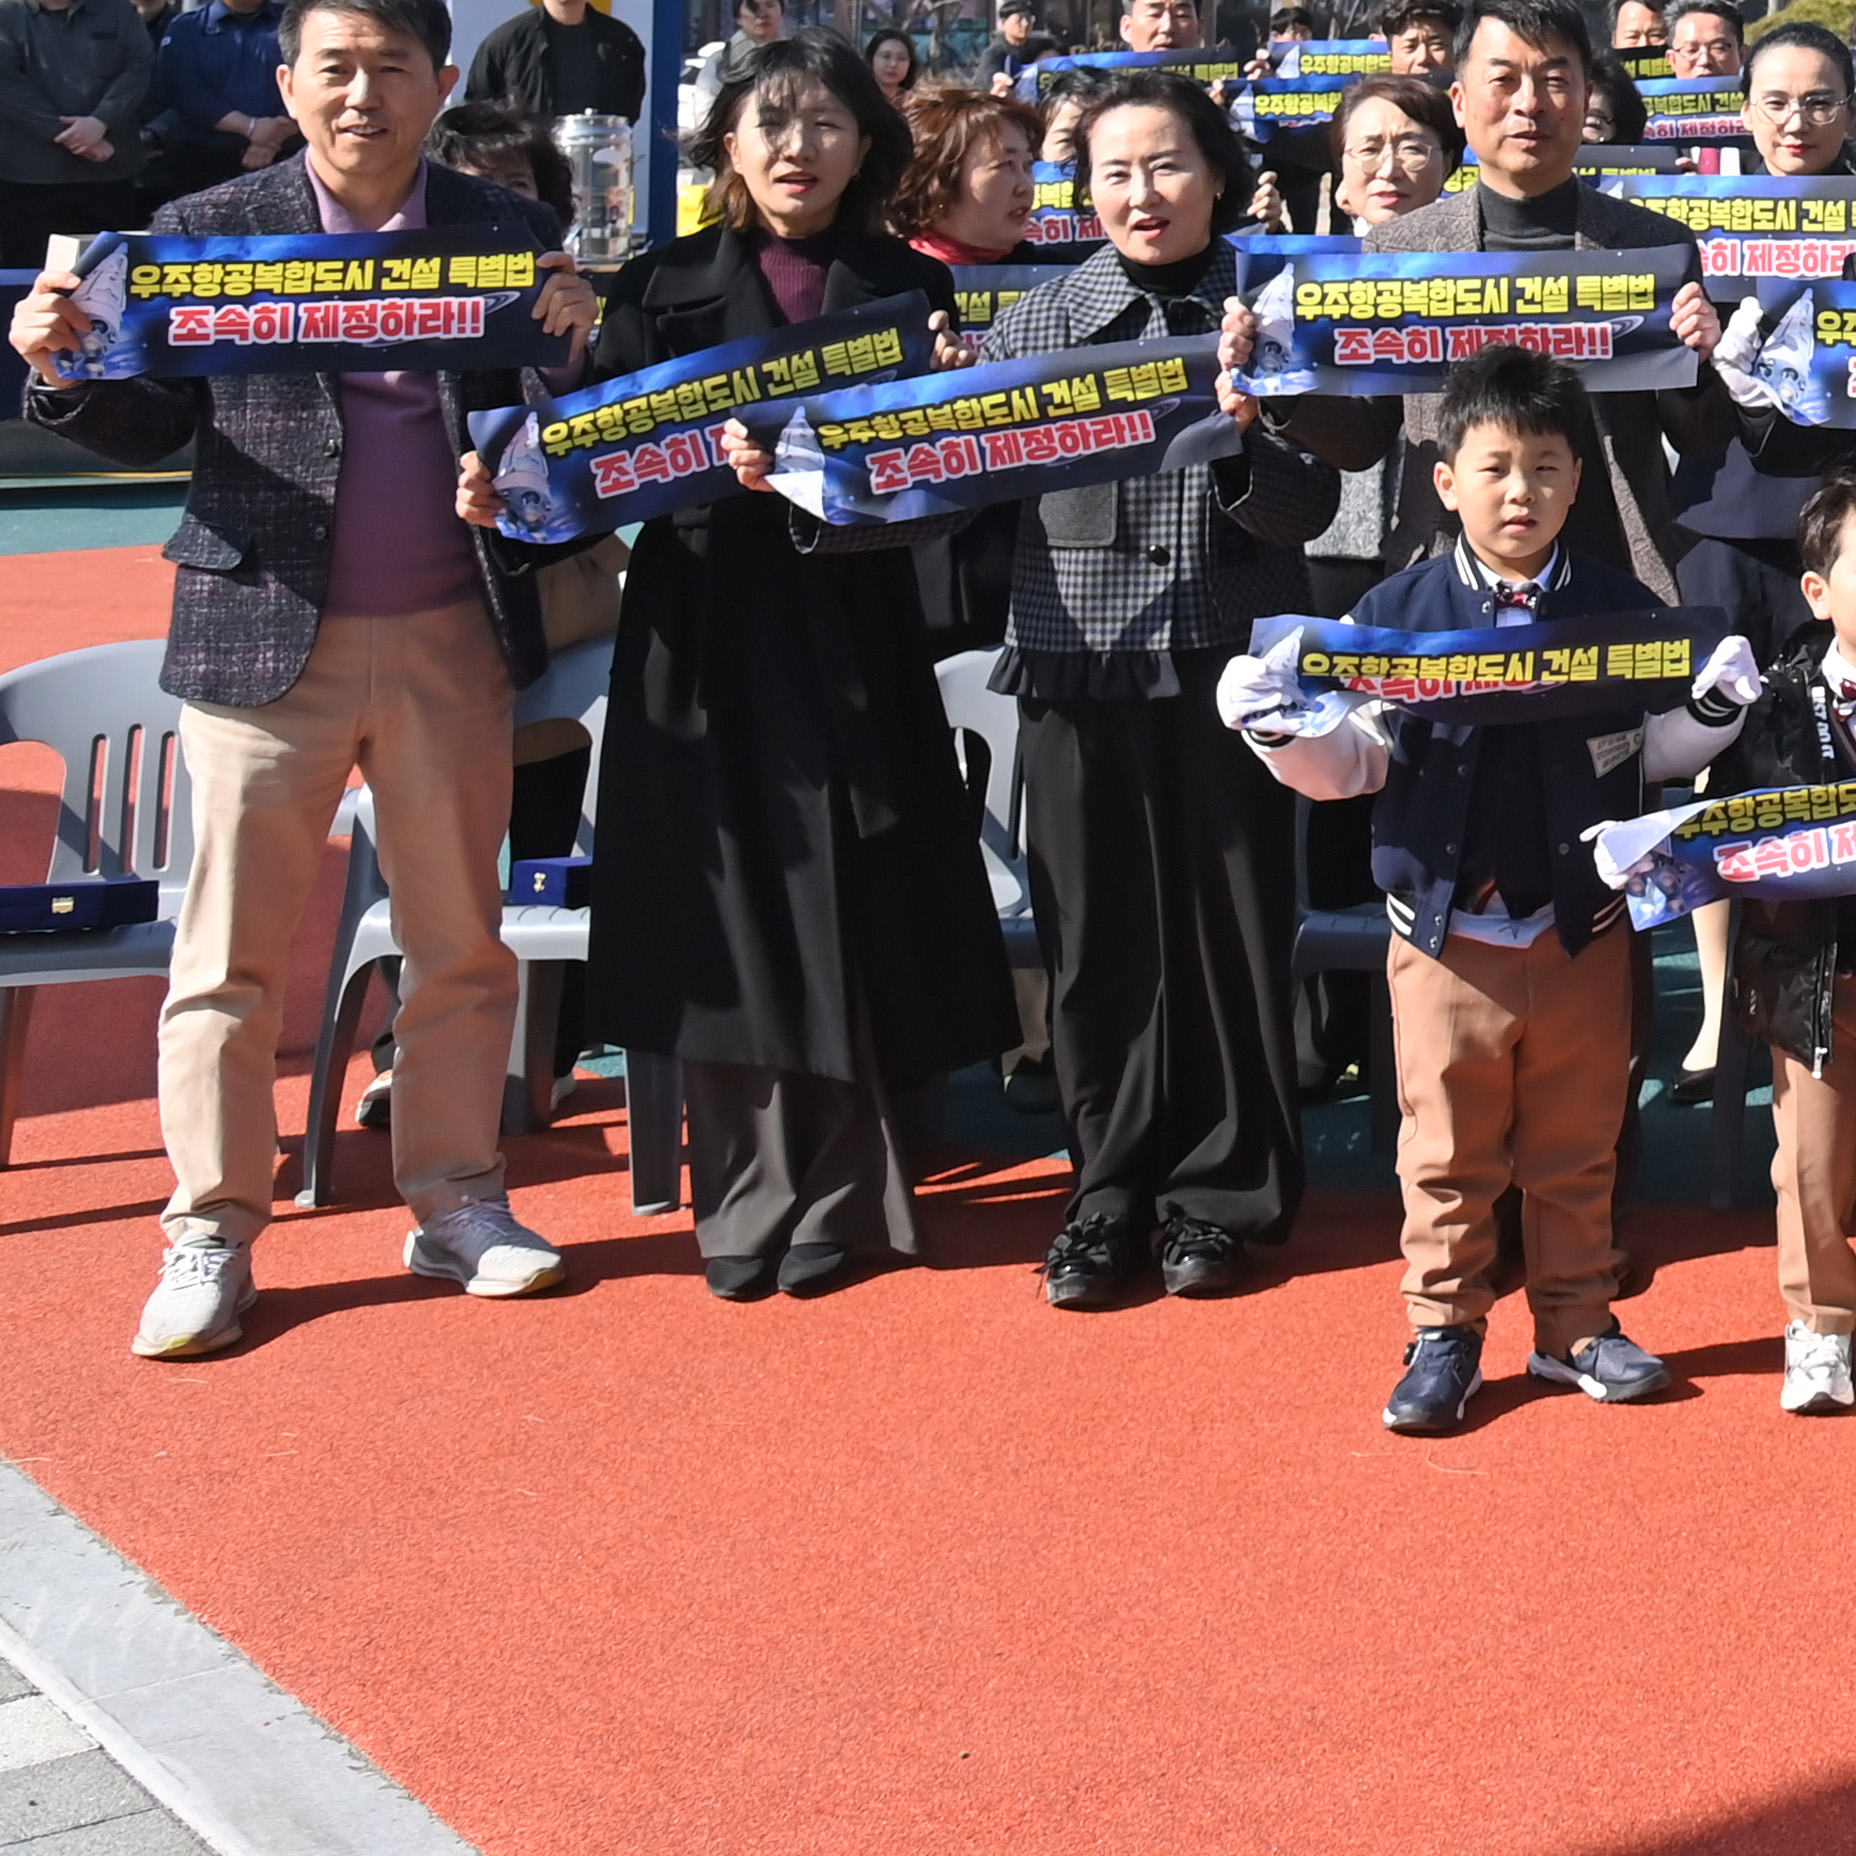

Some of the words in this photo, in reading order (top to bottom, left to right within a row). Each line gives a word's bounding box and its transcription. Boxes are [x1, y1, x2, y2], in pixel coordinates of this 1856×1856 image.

[1803, 200, 1847, 233] 건설
[131, 259, 375, 299] 우주항공복합도시
[381, 256, 442, 291] 건설
[449, 251, 535, 289] 특별법
[1297, 277, 1510, 321] 우주항공복합도시
[1517, 276, 1570, 315] 건설
[1576, 274, 1656, 312] 특별법
[173, 305, 292, 342] 조속히
[303, 300, 482, 339] 제정하라!!
[1338, 328, 1441, 361] 조속히
[542, 367, 761, 455] 우주항공복합도시
[763, 351, 819, 396] 건설
[823, 329, 903, 382] 특별법
[819, 387, 1041, 449] 우주항공복합도시
[1042, 373, 1102, 418] 건설
[1104, 357, 1189, 402] 특별법
[595, 434, 706, 494] 조속히
[871, 437, 980, 491] 조속히
[984, 411, 1153, 467] 제정하라!!
[1542, 646, 1599, 682] 건설
[1608, 639, 1691, 680] 특별법
[1719, 833, 1825, 883] 조속히
